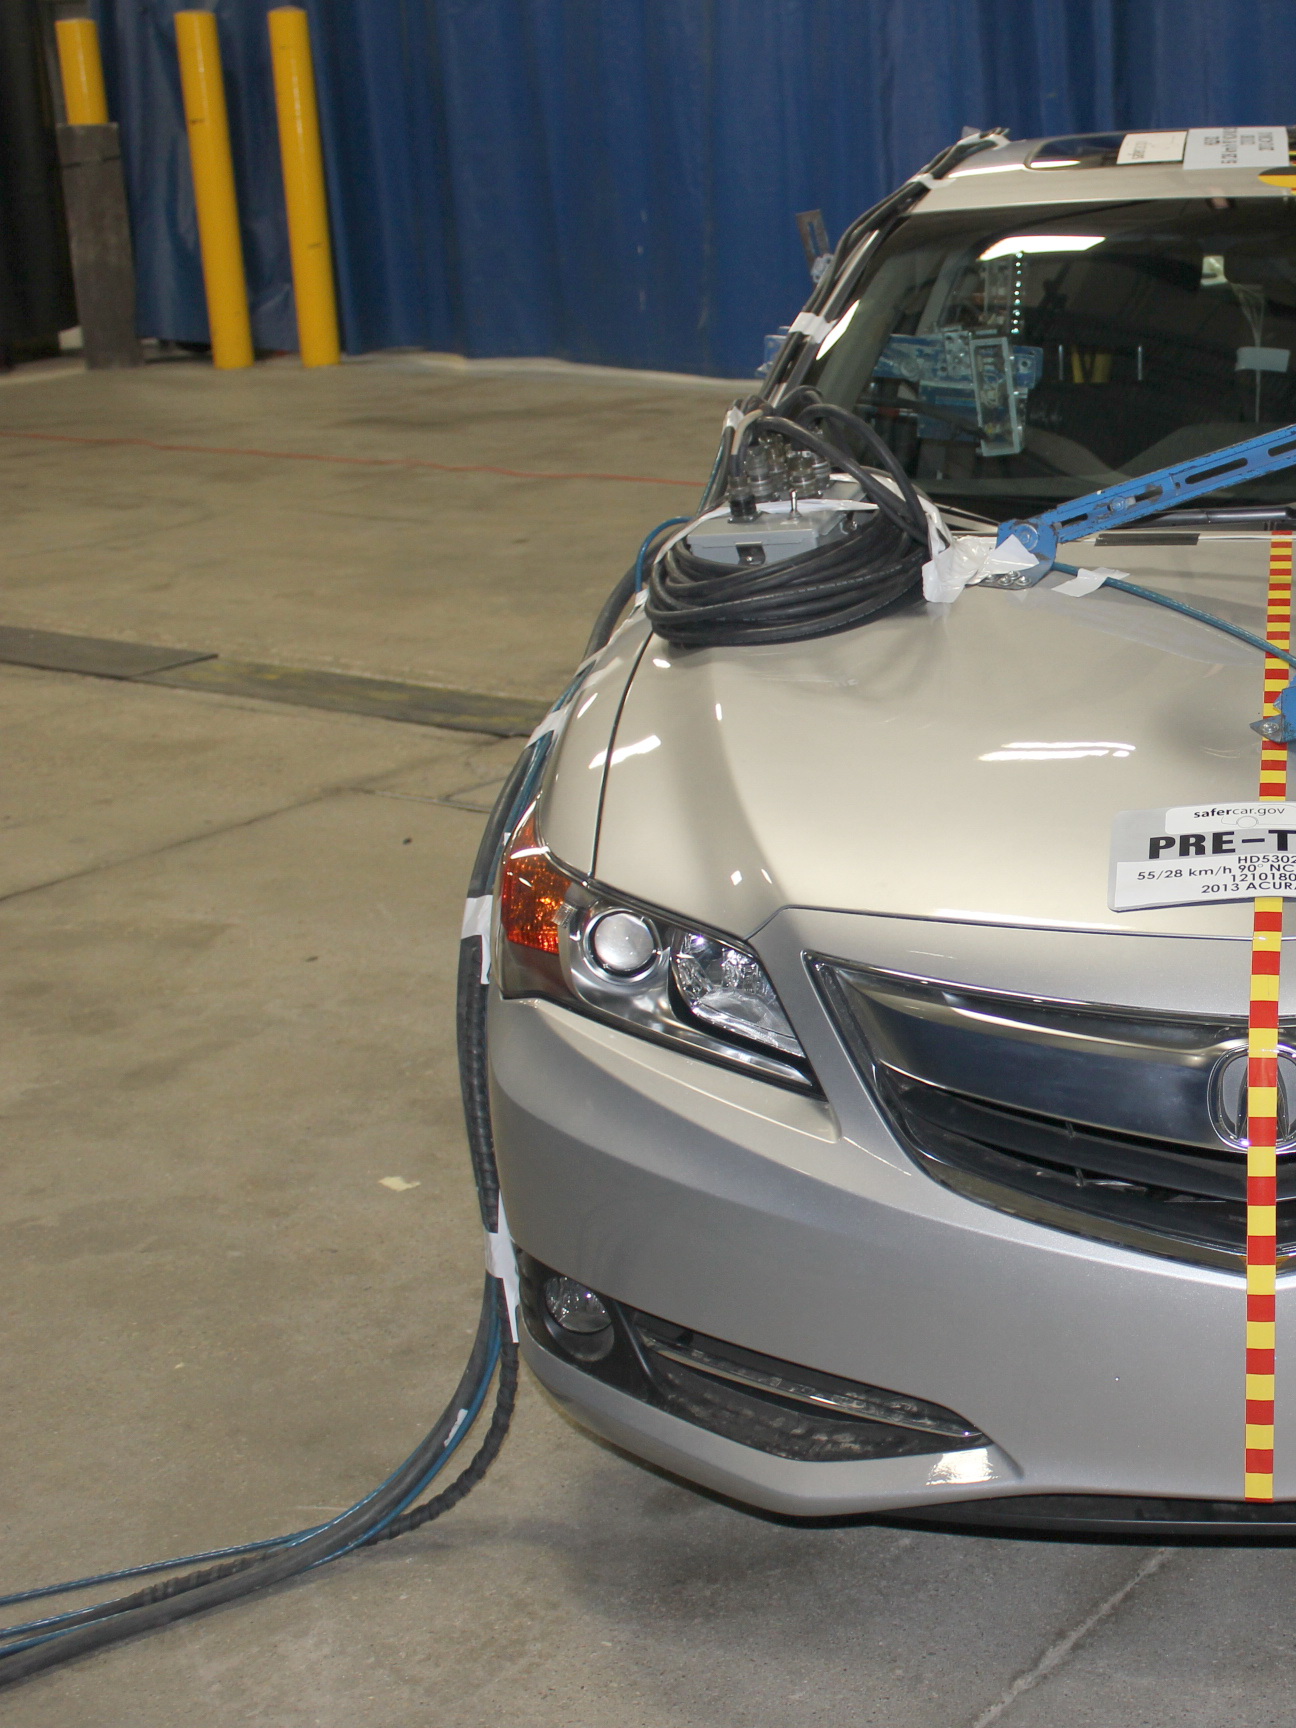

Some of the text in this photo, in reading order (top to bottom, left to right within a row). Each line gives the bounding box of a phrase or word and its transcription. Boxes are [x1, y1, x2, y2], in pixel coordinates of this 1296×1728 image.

[1193, 806, 1285, 818] safercar.gov
[1137, 869, 1182, 880] 55/28
[1188, 865, 1232, 877] km/h
[1201, 883, 1240, 893] 2013
